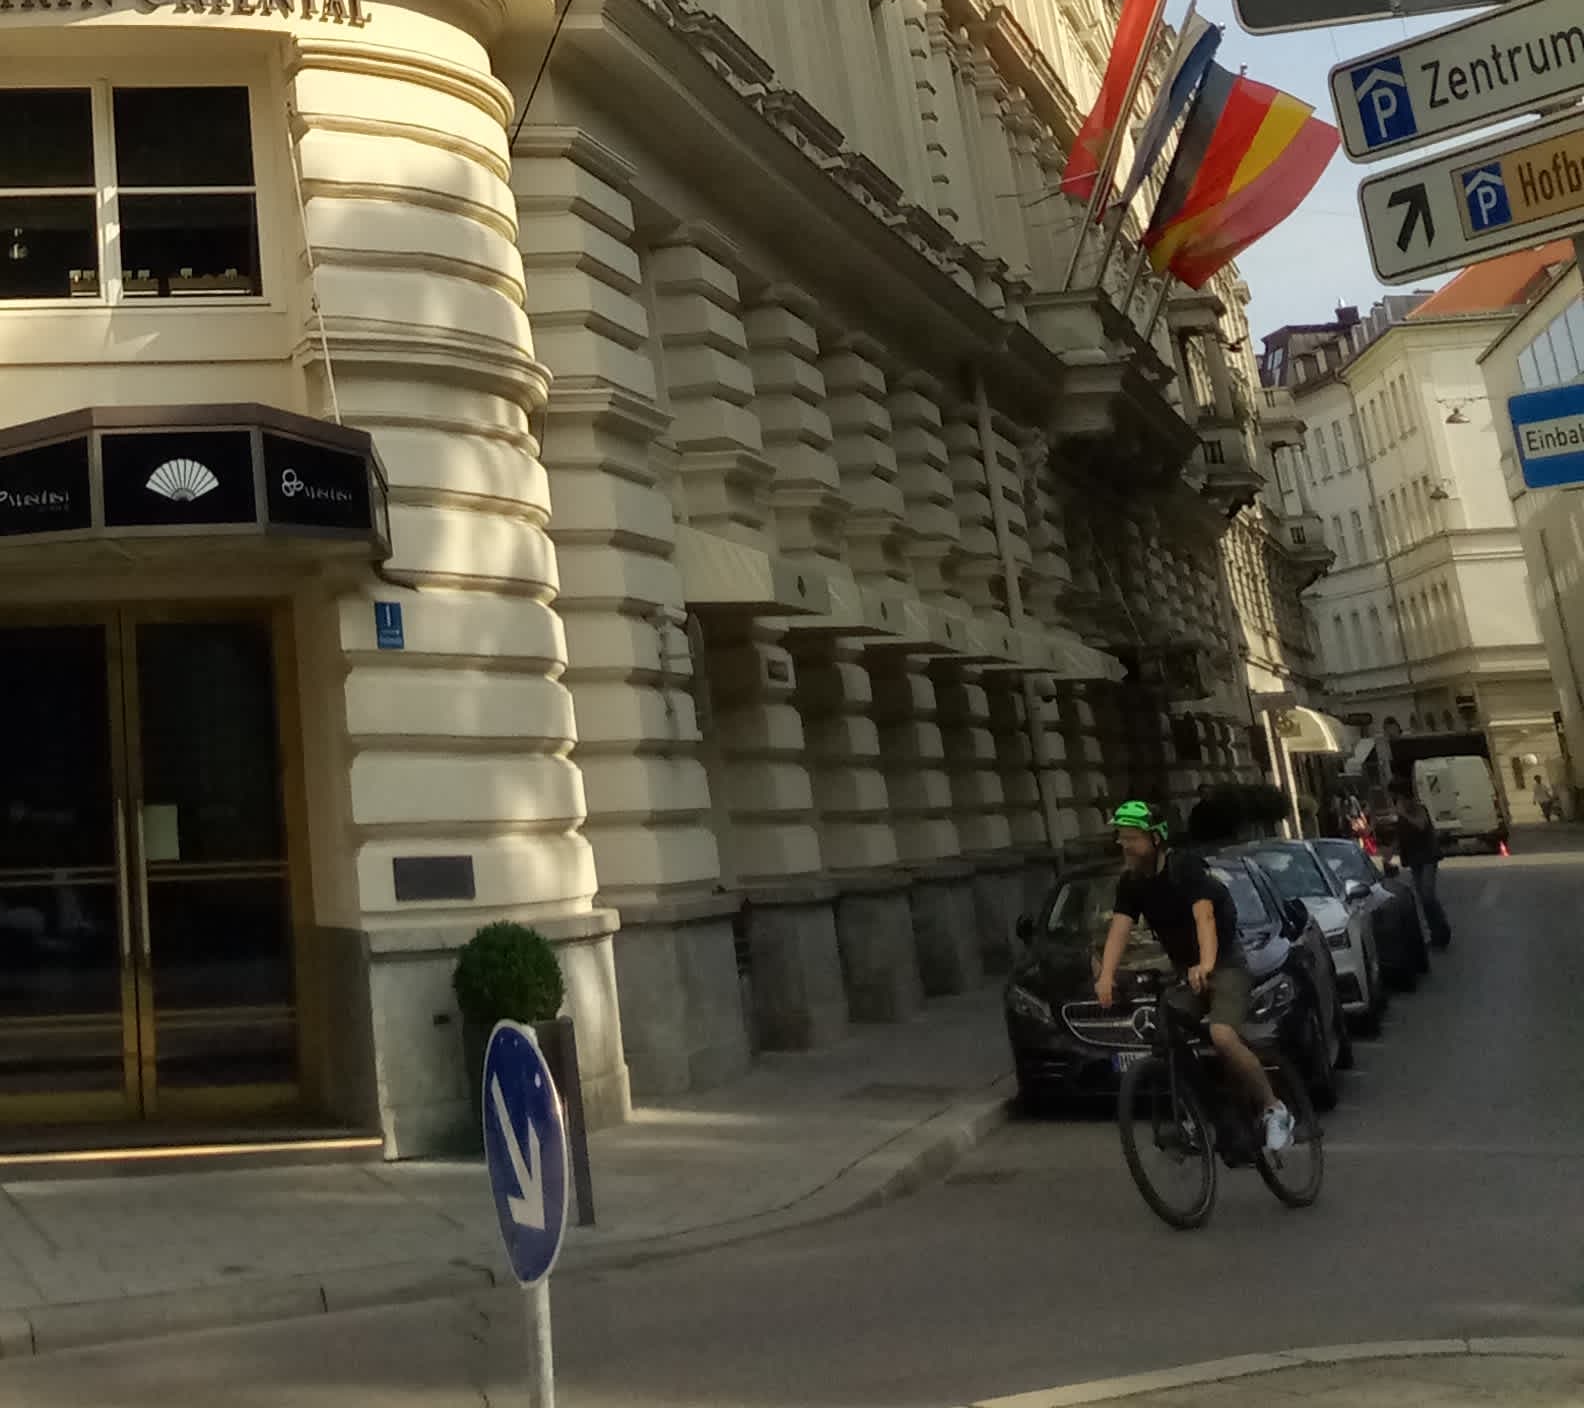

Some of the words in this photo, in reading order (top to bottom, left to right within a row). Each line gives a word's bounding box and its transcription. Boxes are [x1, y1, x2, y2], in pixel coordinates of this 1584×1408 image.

[1371, 86, 1398, 139] P
[1420, 26, 1584, 110] Zentrum
[1476, 185, 1498, 225] P
[1518, 150, 1584, 208] Hofb
